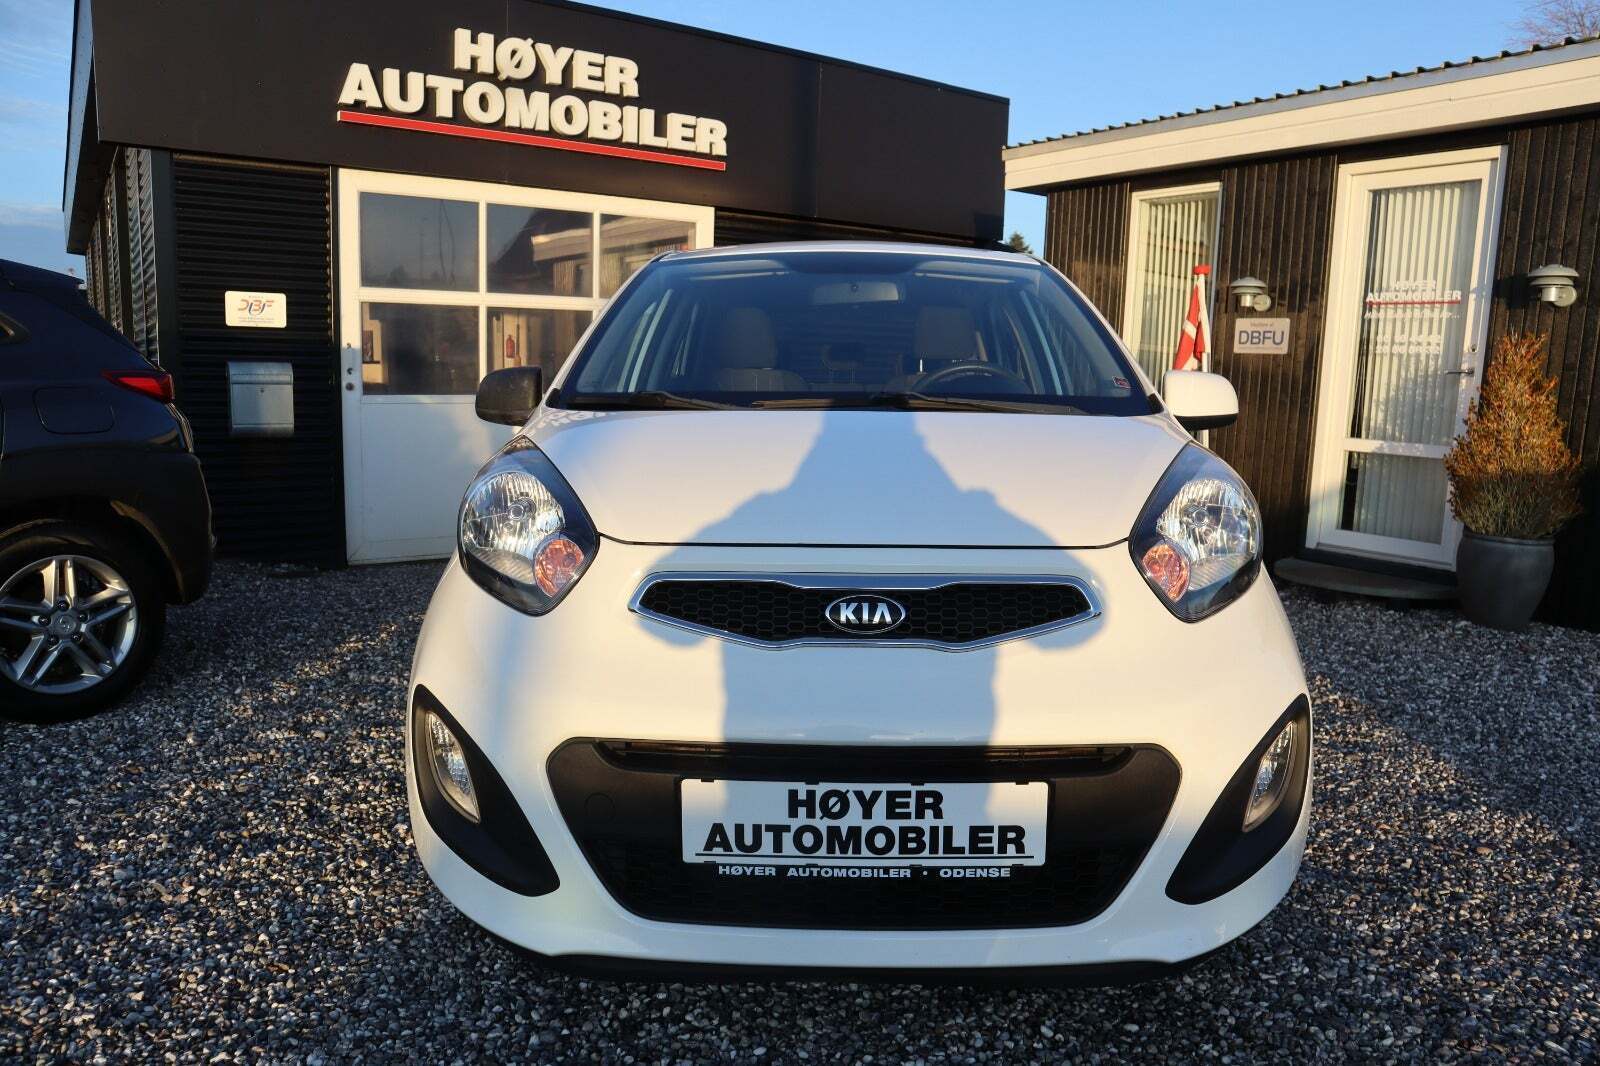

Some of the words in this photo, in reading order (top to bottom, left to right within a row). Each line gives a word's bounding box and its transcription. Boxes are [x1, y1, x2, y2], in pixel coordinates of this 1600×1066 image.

[454, 28, 640, 97] HØYER
[338, 62, 728, 156] AUTOMOBILER
[1239, 330, 1284, 345] DBFU
[840, 602, 893, 624] KIA
[787, 788, 944, 820] HØYER
[703, 823, 1026, 856] AUTOMOBILER
[718, 865, 776, 877] HØYER
[787, 867, 911, 878] AUTOMOBILER
[939, 868, 1011, 878] ODENSE
